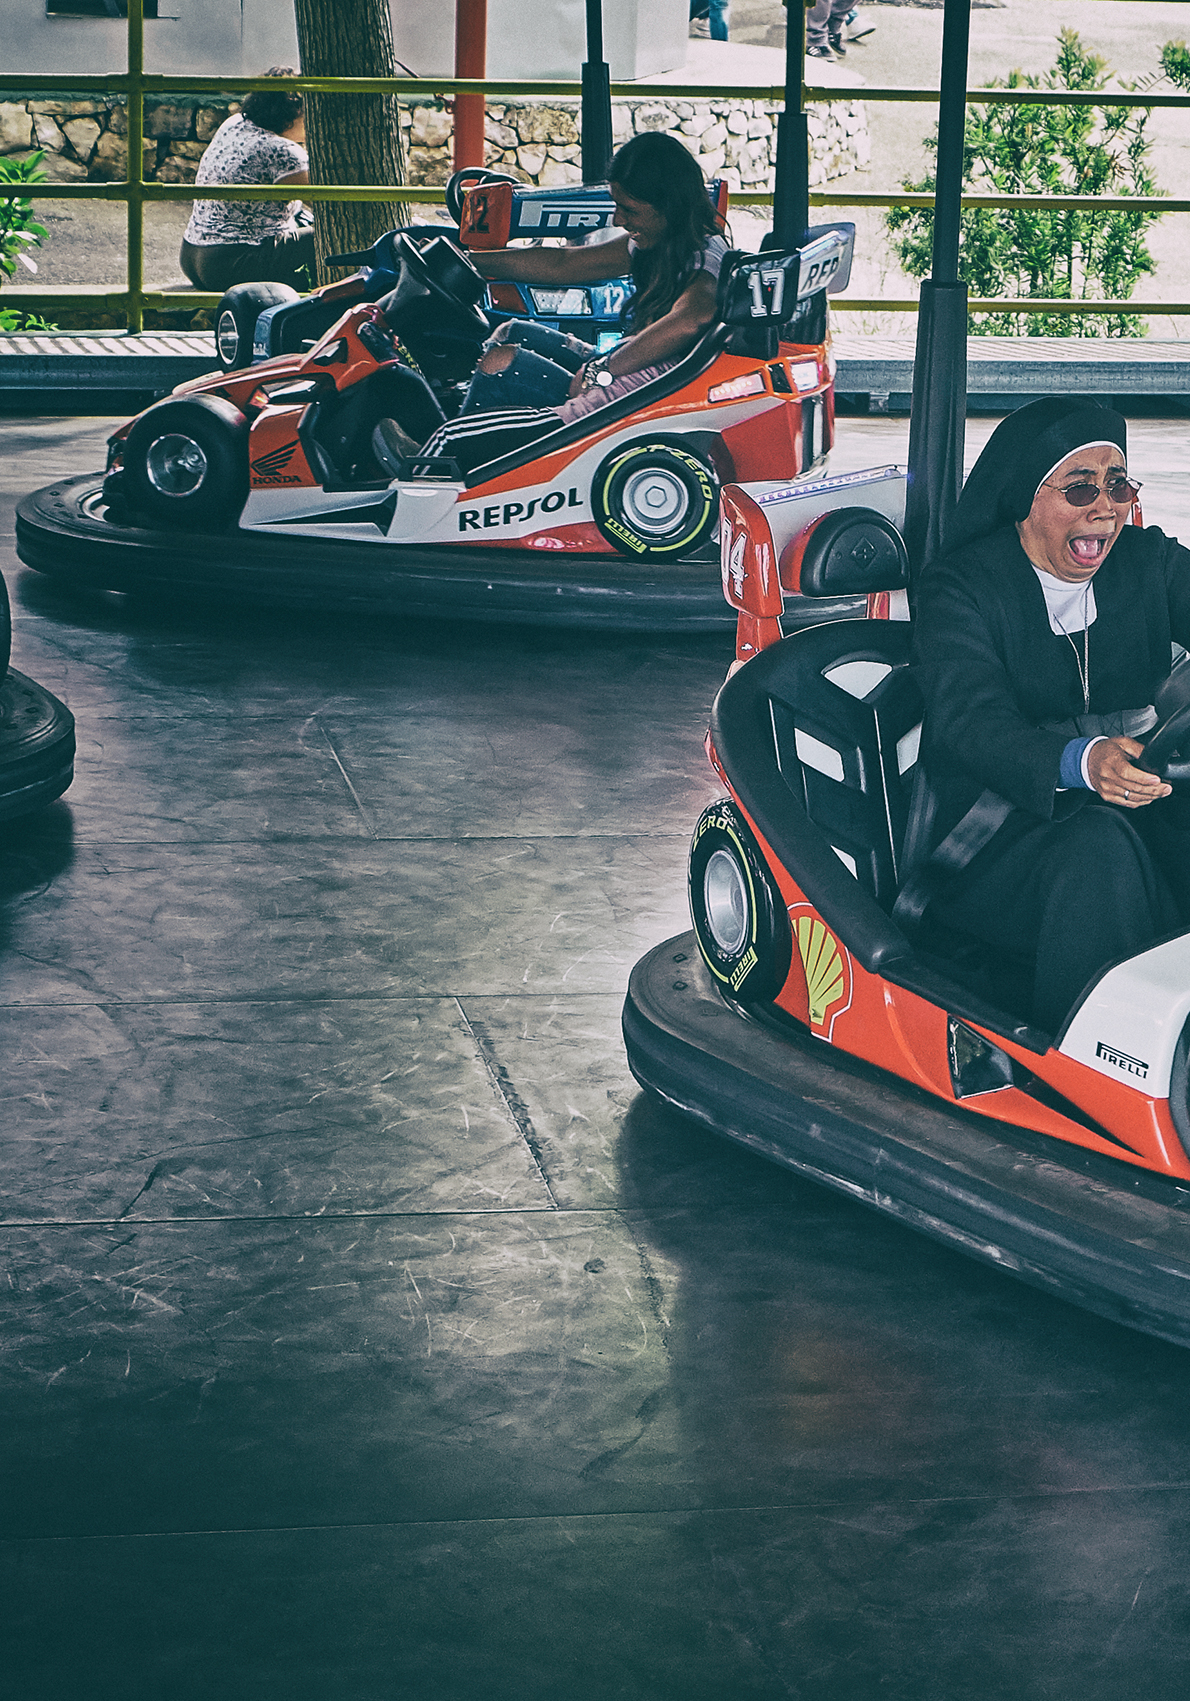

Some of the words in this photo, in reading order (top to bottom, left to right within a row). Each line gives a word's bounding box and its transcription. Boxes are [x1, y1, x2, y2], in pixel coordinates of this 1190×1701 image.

[518, 201, 617, 227] PIR
[603, 286, 625, 315] 12
[747, 268, 785, 317] 17
[252, 475, 302, 485] HONDA
[458, 487, 584, 532] REPSOL
[604, 517, 648, 554] PIRELLI
[730, 945, 758, 992] PIRELLI
[1096, 1041, 1150, 1079] PIRELLI
